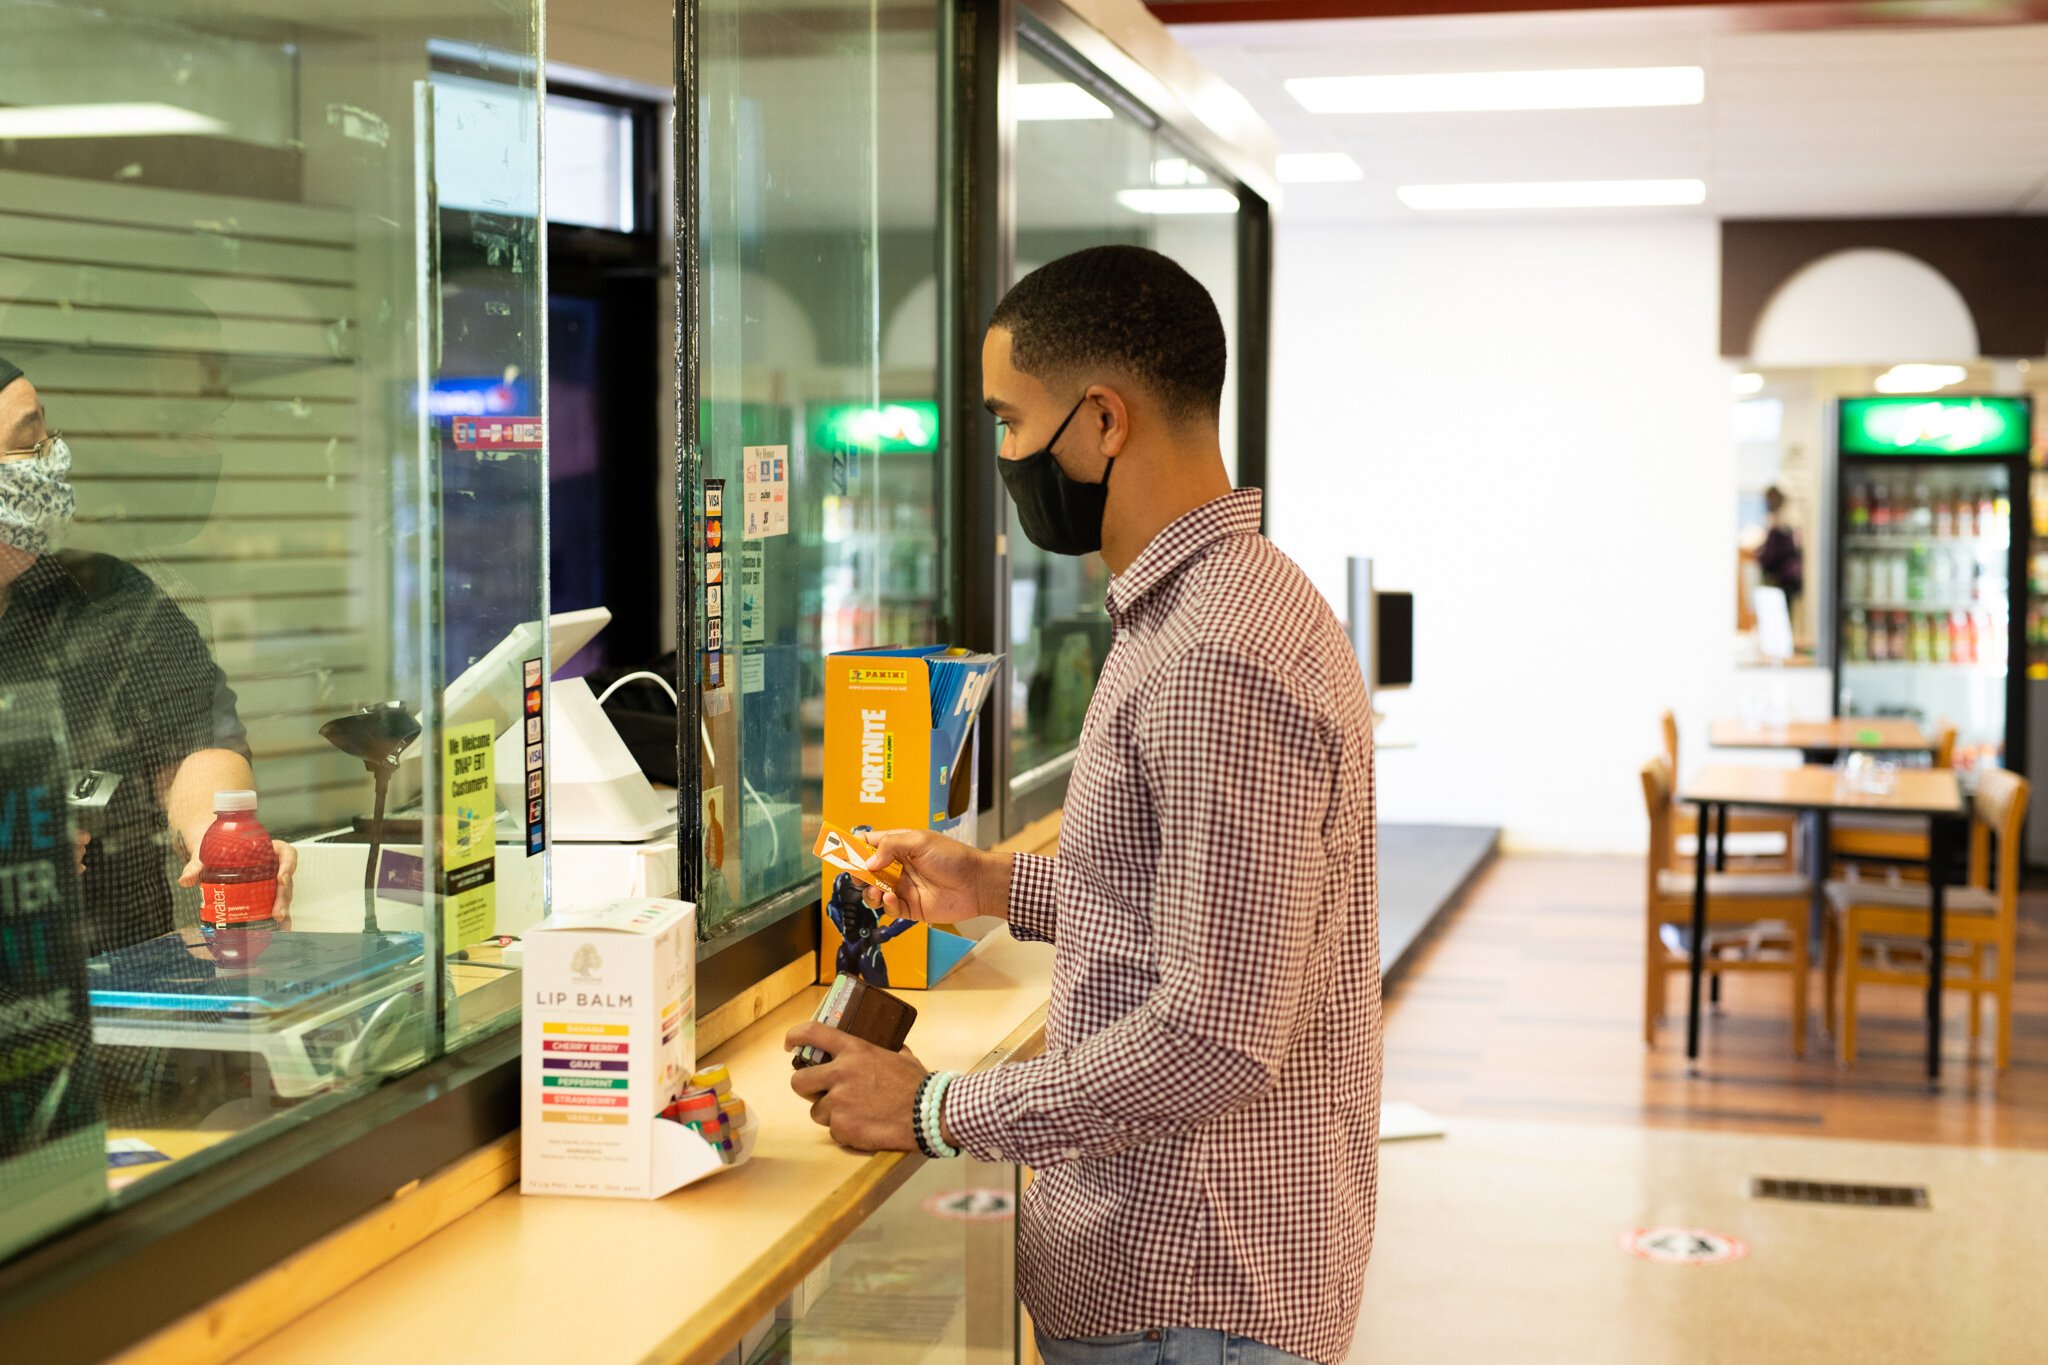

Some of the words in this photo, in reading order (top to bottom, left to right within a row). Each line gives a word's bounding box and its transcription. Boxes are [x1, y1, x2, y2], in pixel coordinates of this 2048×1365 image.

[708, 495, 719, 507] VISA
[865, 671, 905, 679] PANINI
[449, 737, 459, 756] We
[462, 734, 490, 753] Welcome
[474, 752, 486, 771] EBT
[529, 748, 542, 764] VISA
[859, 709, 887, 804] FORTNITE
[452, 776, 488, 798] Customers
[875, 879, 893, 893] VISA
[536, 991, 568, 1006] LIP
[576, 992, 634, 1008] BALM
[551, 1041, 589, 1051] CHERRY
[589, 1043, 620, 1053] BERRY
[569, 1060, 603, 1070] GRAPE
[557, 1077, 614, 1088] PEPPERMINT
[553, 1094, 618, 1106] STRAWBERRY
[566, 1114, 605, 1123] VANILLA
